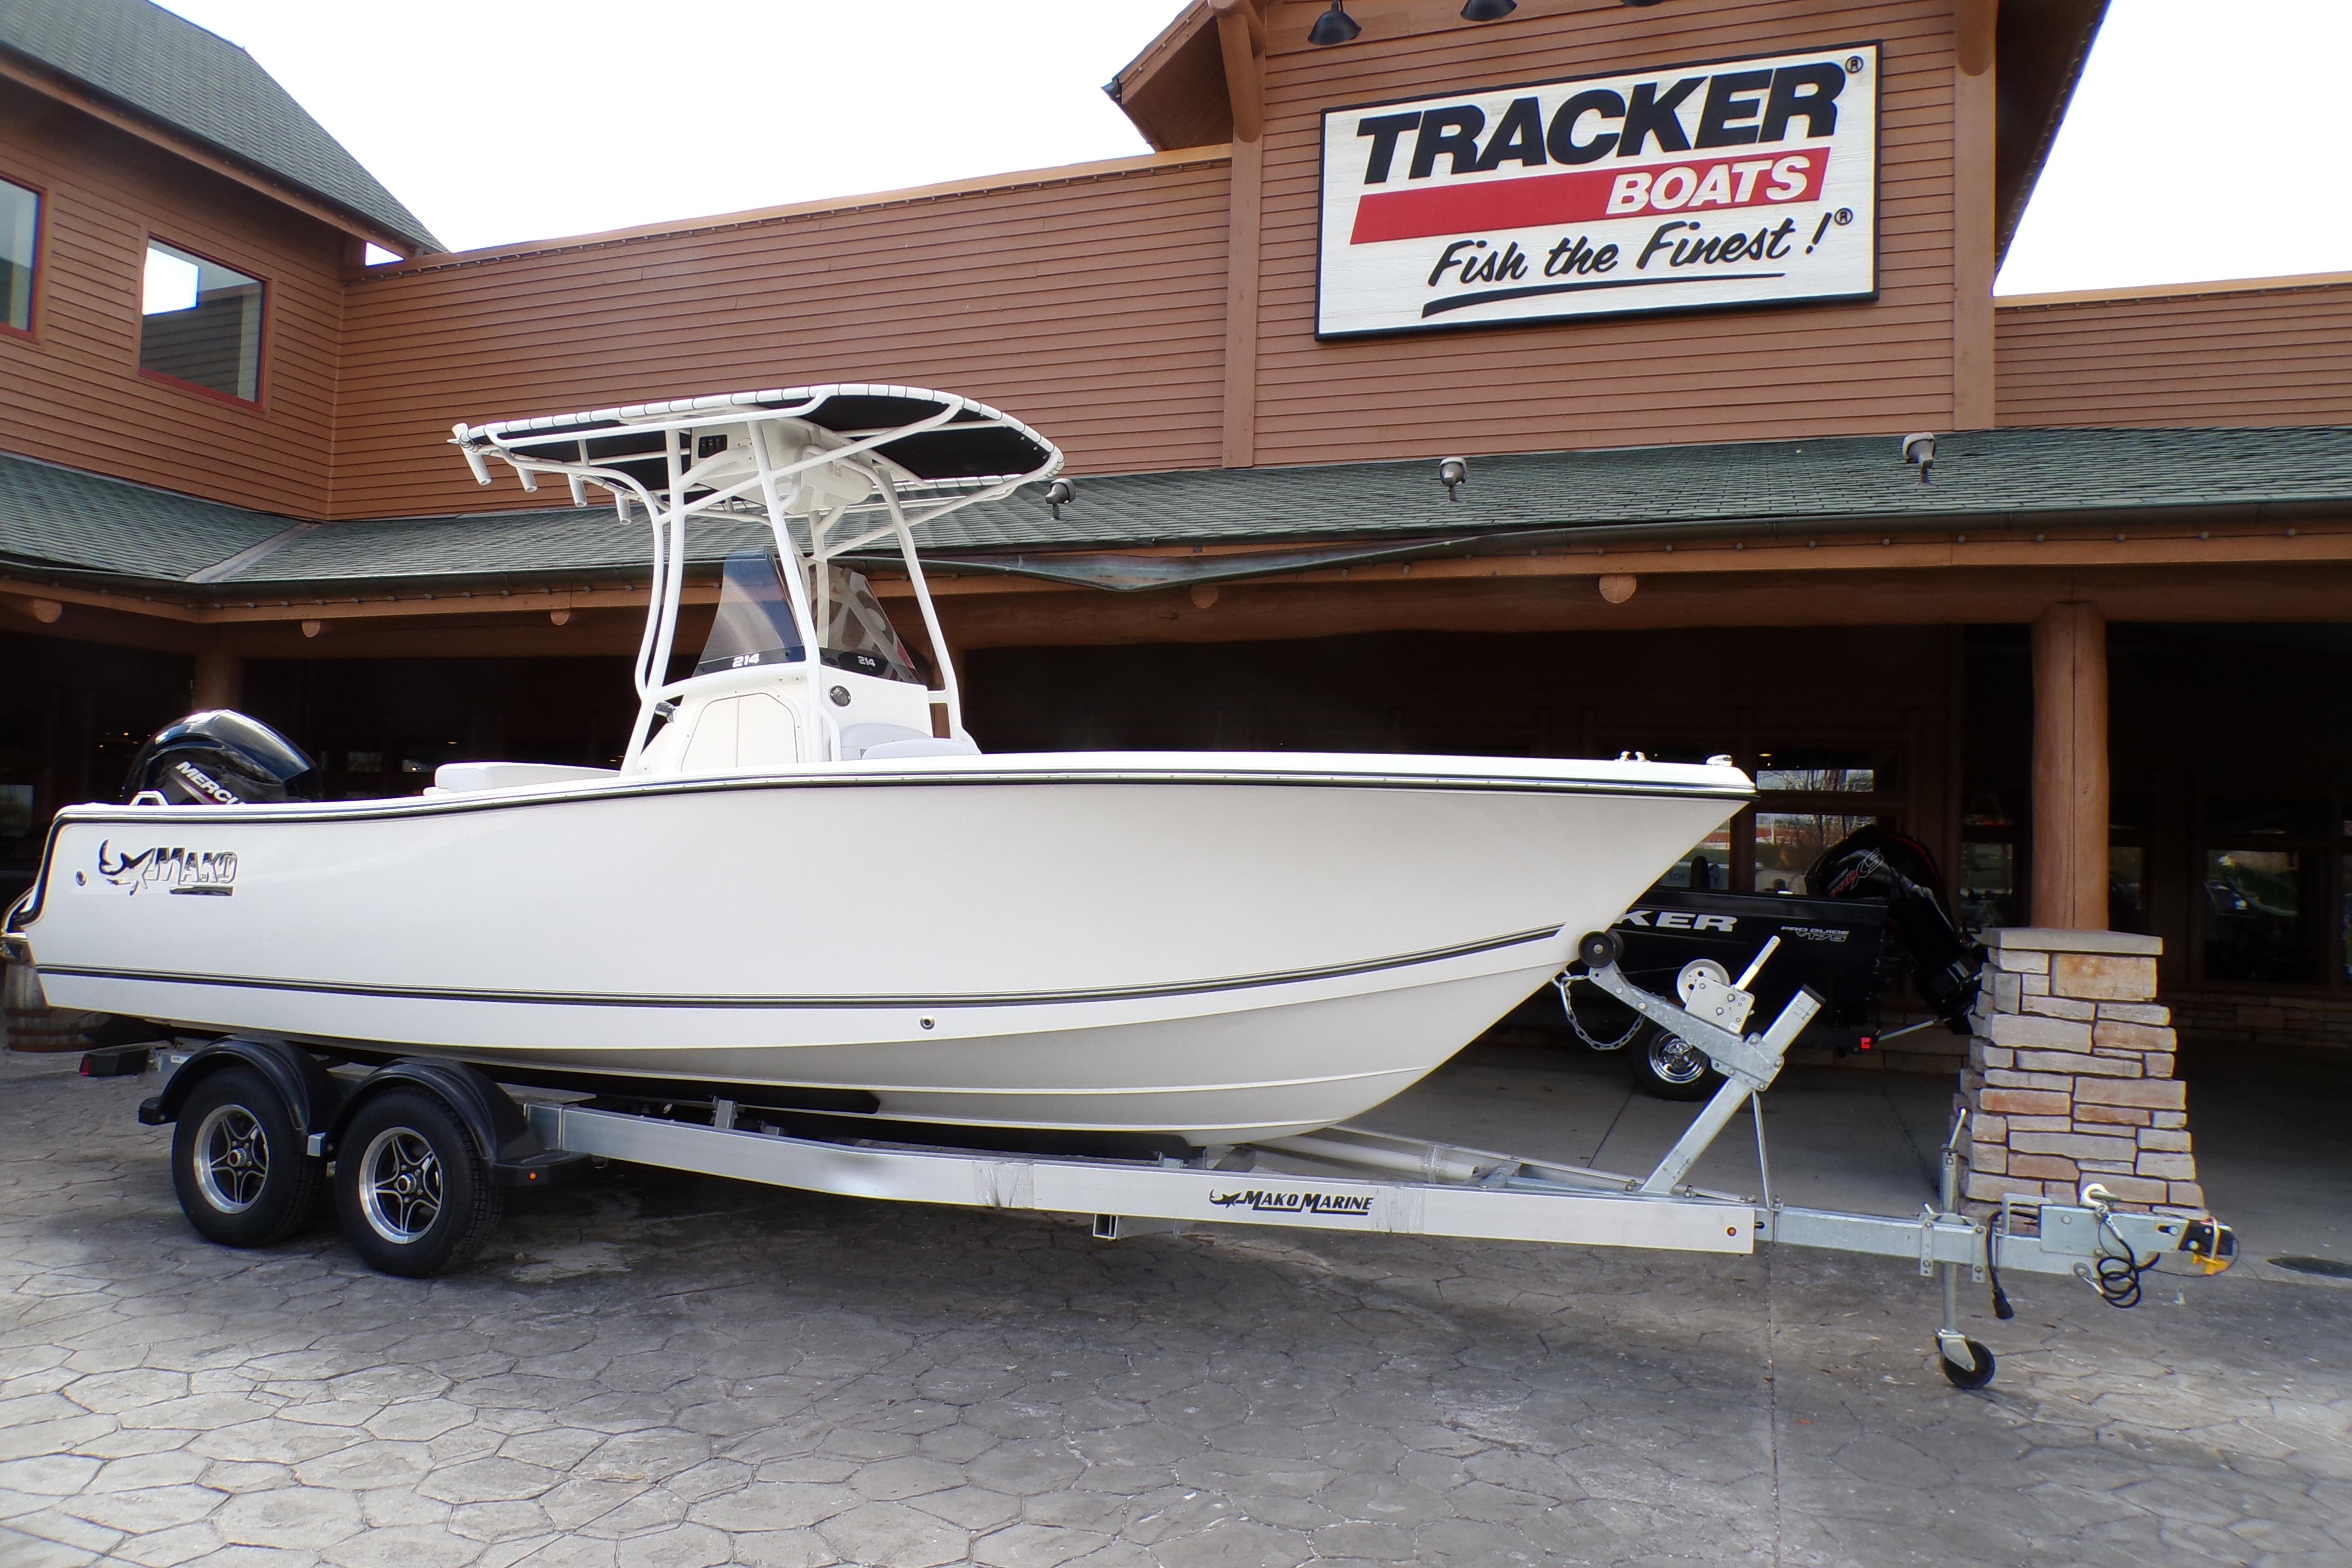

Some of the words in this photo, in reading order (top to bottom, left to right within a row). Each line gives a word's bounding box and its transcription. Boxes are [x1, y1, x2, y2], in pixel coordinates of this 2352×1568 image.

[1605, 155, 1812, 215] BOATS
[1427, 240, 1529, 287] Fish
[1544, 235, 1618, 274] the
[732, 653, 760, 667] 214
[858, 656, 876, 667] 214
[145, 847, 238, 885] MAKO
[1241, 1190, 1300, 1211] MAKO
[1301, 1193, 1374, 1213] MARINE
